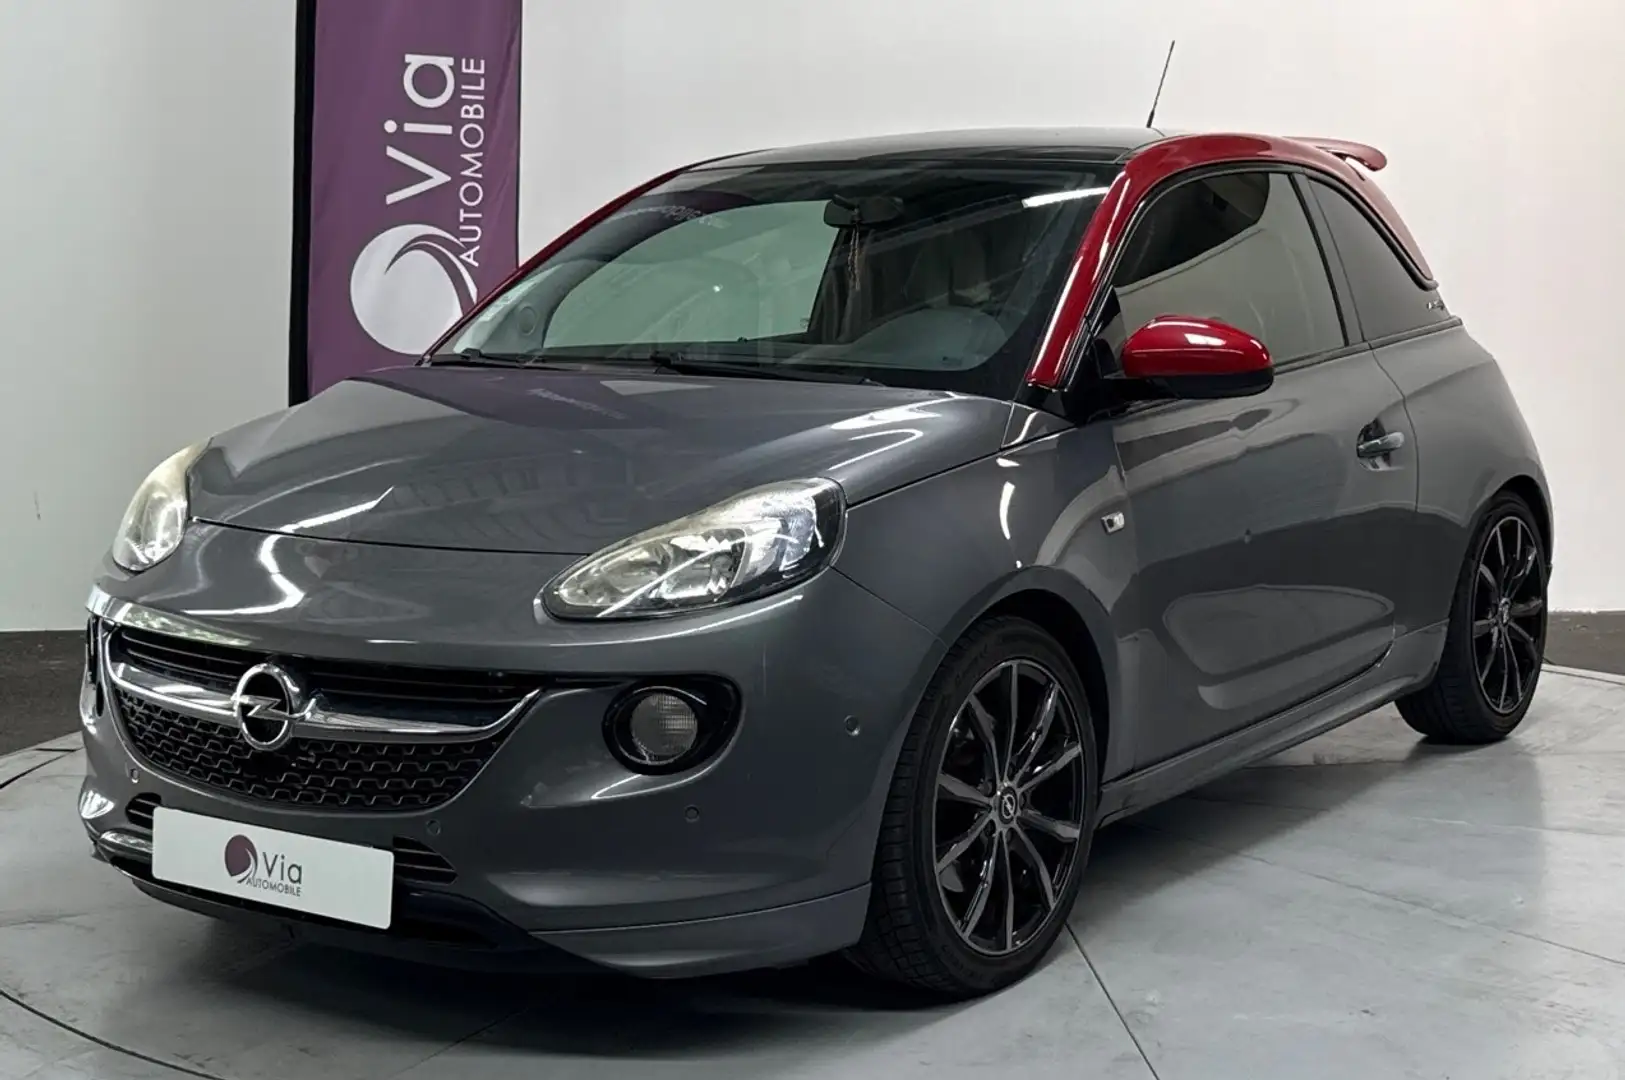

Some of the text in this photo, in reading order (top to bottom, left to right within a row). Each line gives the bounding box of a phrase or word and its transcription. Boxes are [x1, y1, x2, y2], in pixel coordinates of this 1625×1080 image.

[384, 53, 454, 205] Via
[459, 57, 485, 267] AUTOMOBILE
[246, 876, 301, 897] AUTOMOBILE
[262, 851, 302, 884] Via
